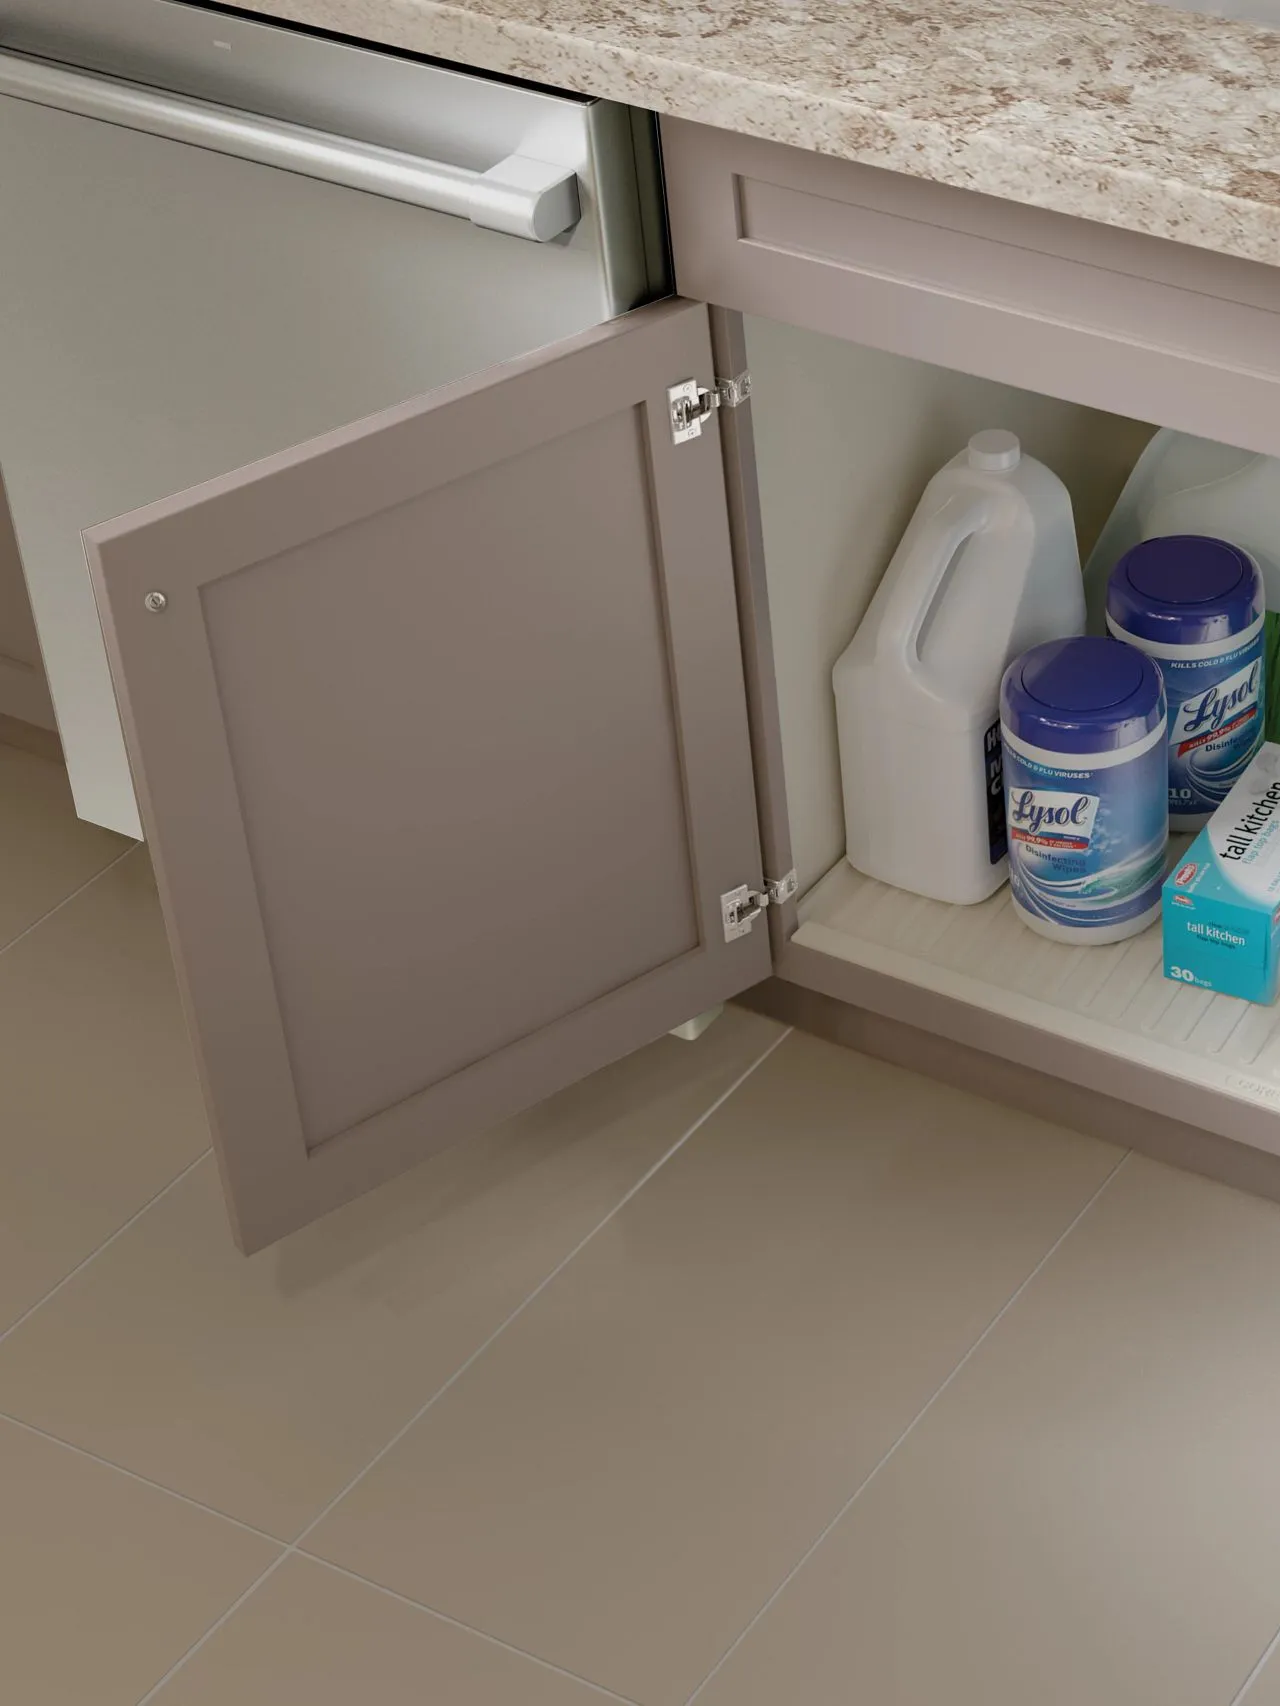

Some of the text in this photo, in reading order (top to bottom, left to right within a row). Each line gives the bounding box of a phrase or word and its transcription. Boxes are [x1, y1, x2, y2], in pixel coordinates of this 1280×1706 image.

[1183, 660, 1259, 732] Lysol
[1011, 790, 1089, 834] Lysol
[1219, 834, 1253, 861] tall
[1187, 921, 1204, 935] tall
[1206, 925, 1246, 946] kitchen
[1171, 965, 1194, 982] 30
